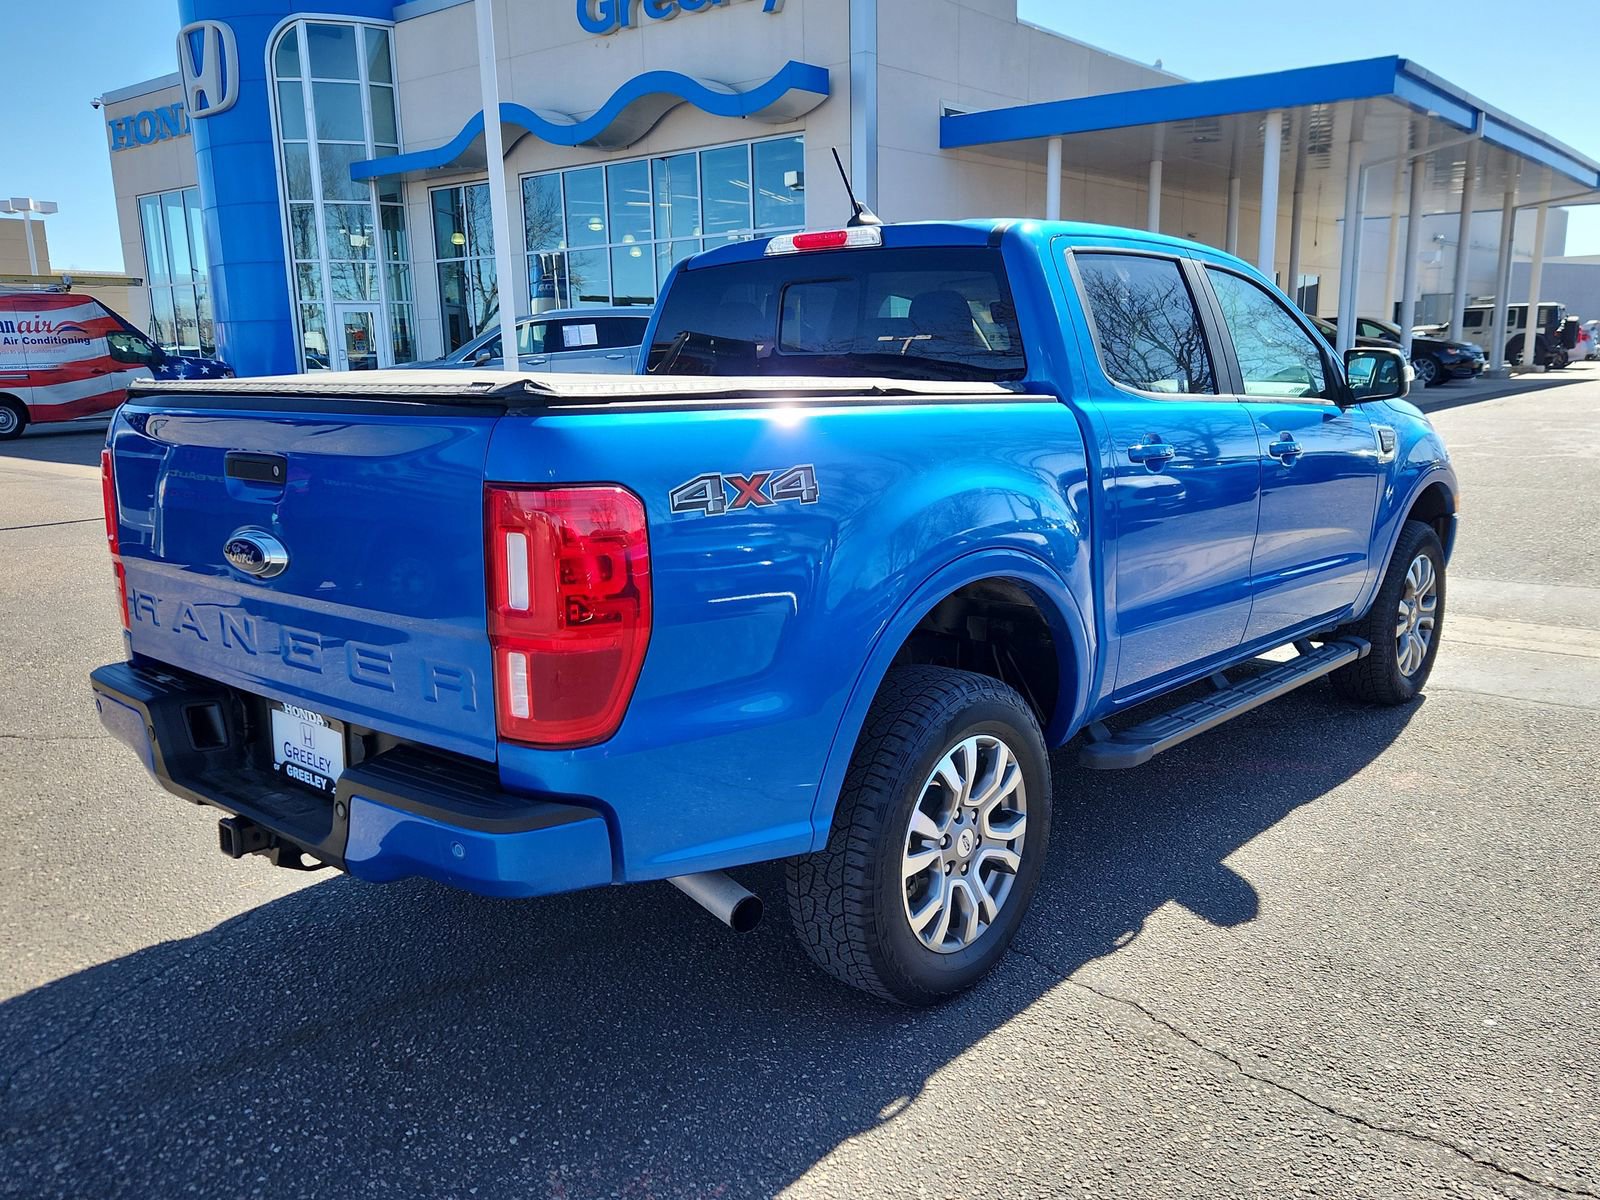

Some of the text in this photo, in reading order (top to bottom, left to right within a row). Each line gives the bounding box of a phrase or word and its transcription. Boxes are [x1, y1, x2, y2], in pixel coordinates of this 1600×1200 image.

[108, 101, 192, 152] HON
[3, 334, 91, 347] Air Conditioning
[230, 541, 256, 566] Ford
[132, 586, 478, 713] RANGER
[282, 702, 325, 727] HONDA
[283, 741, 332, 775] GREELEY
[286, 764, 328, 791] GREELEY
